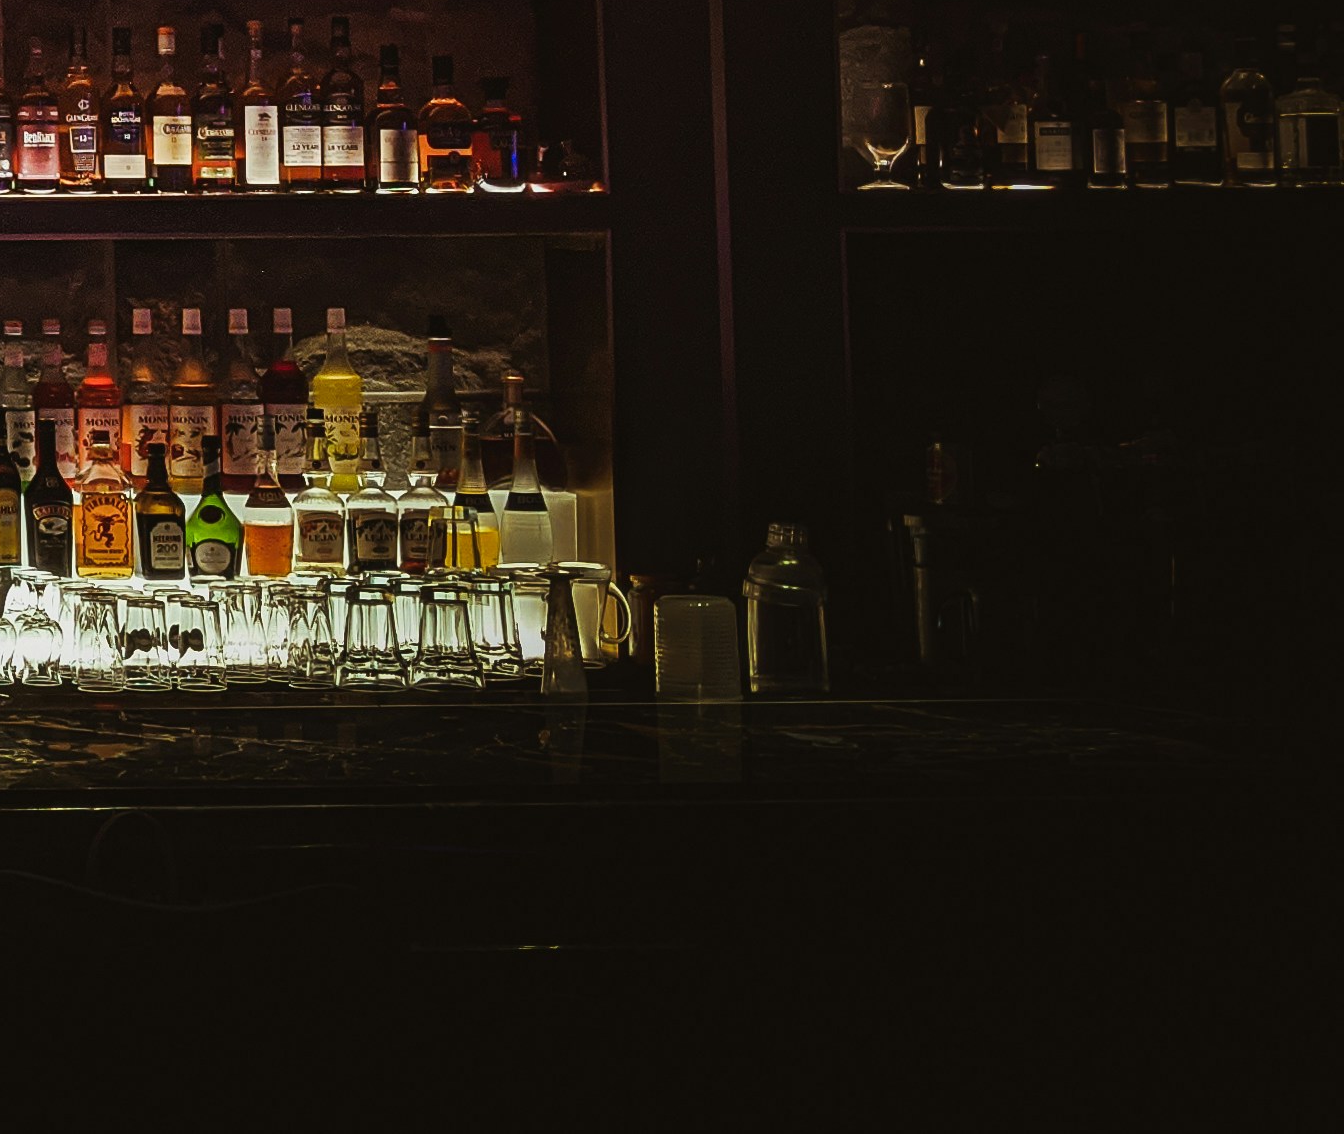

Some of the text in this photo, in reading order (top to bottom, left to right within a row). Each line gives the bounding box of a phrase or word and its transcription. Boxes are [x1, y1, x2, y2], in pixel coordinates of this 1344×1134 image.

[309, 533, 337, 542] LEJAY
[365, 534, 394, 542] LEJAY
[157, 544, 178, 553] 200
